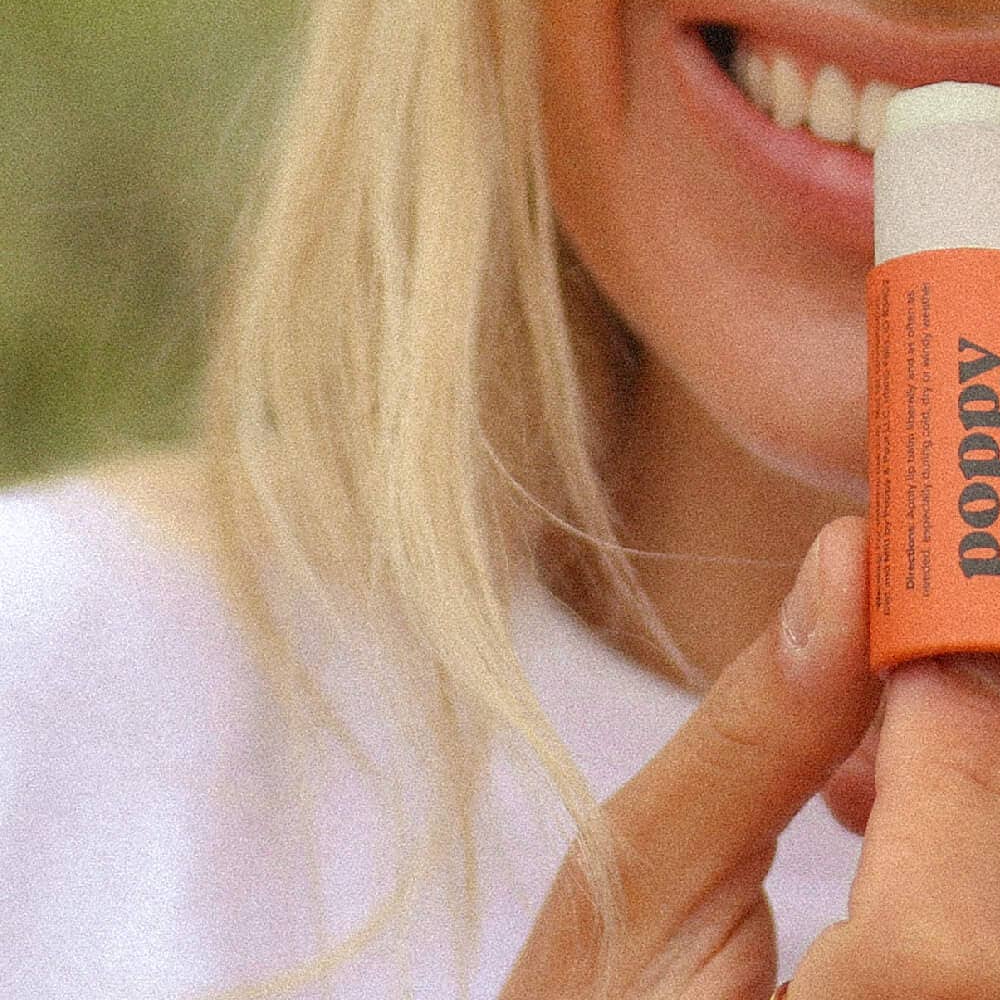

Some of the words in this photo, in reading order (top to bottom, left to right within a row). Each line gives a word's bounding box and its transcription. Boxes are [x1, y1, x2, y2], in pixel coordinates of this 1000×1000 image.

[906, 308, 914, 338] often
[908, 343, 914, 354] as
[921, 332, 932, 367] windy
[922, 371, 930, 382] or
[906, 384, 916, 430] liberally
[921, 387, 932, 404] dry
[906, 434, 915, 462] balm
[921, 440, 933, 479] during
[906, 466, 916, 480] lip
[921, 484, 933, 543] especially
